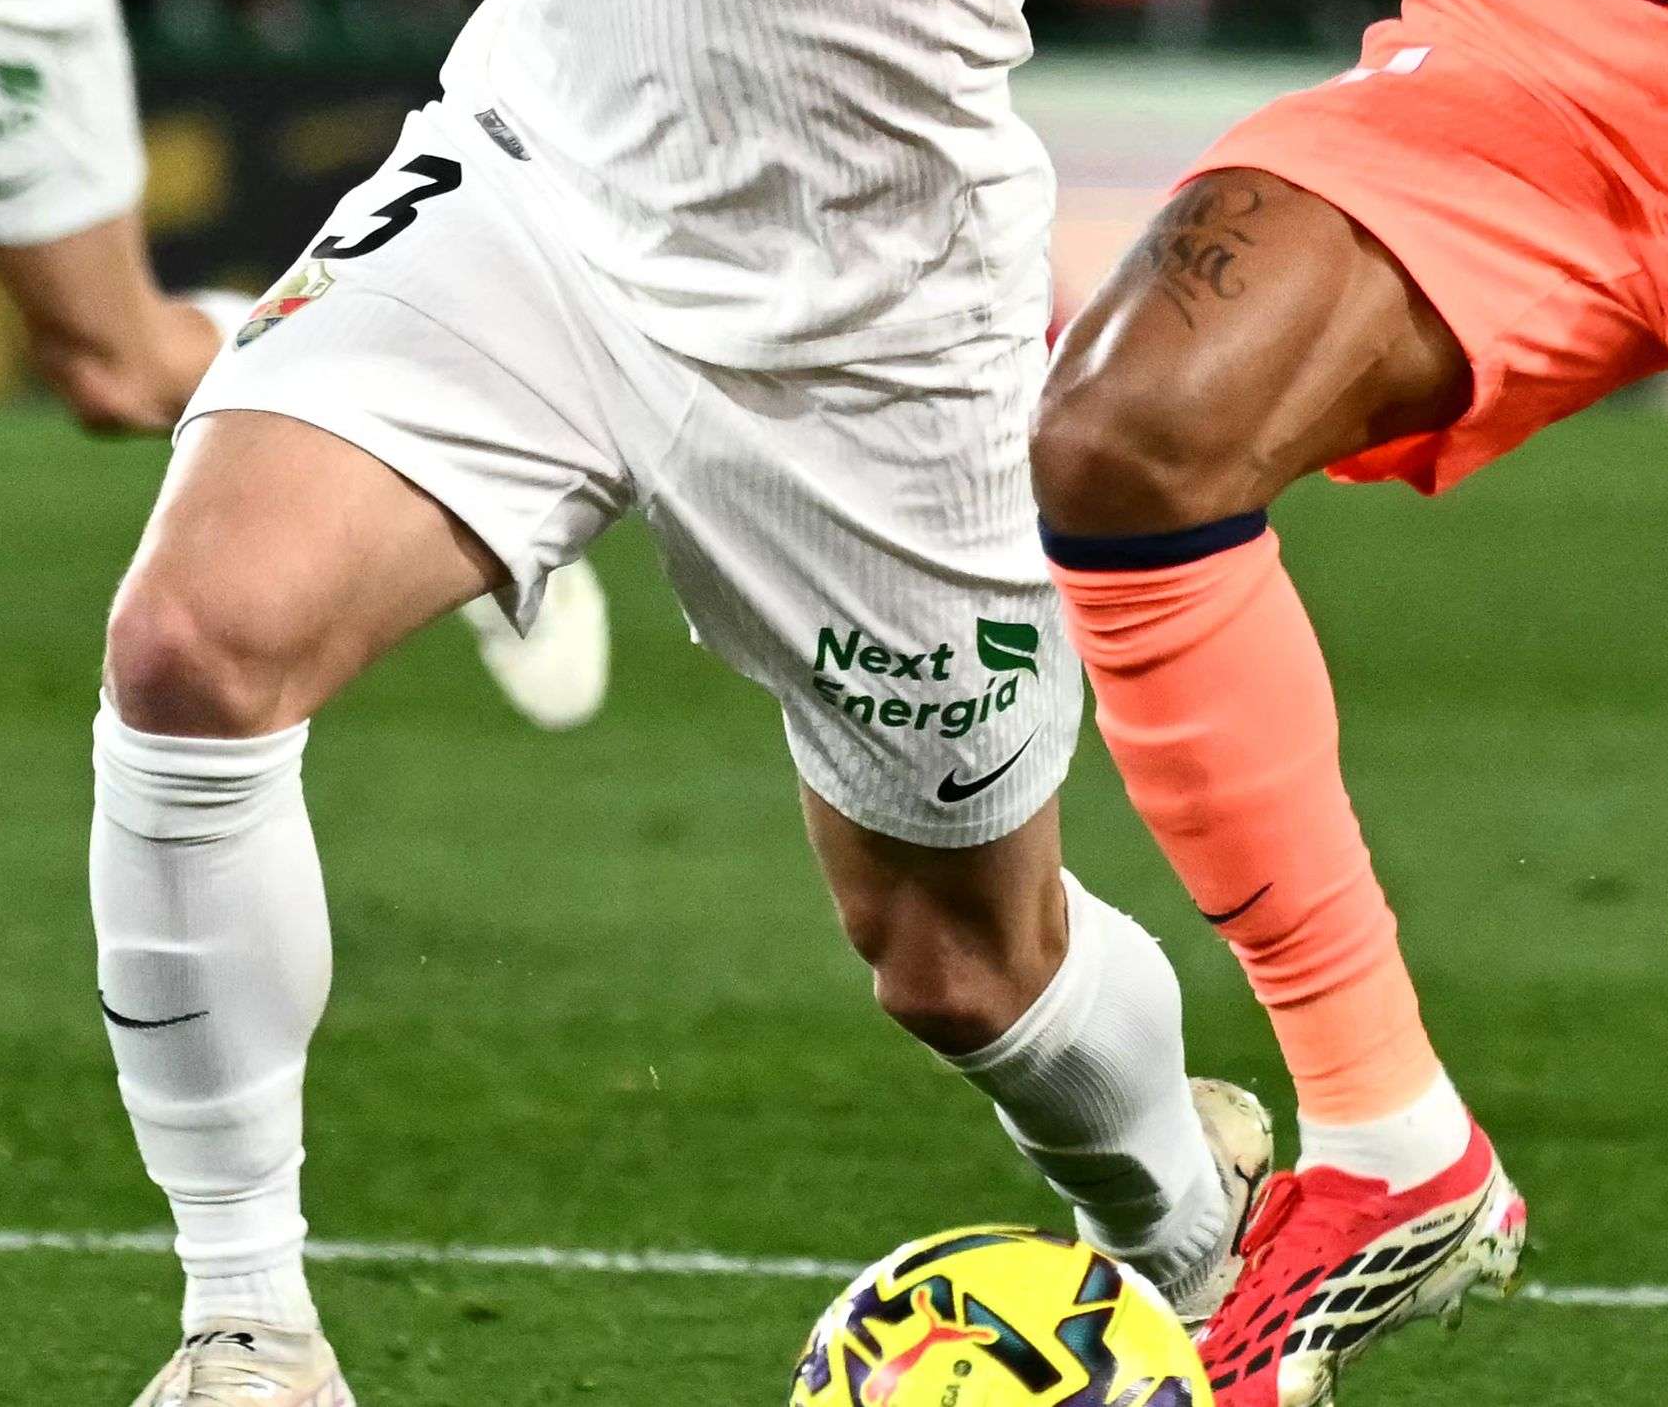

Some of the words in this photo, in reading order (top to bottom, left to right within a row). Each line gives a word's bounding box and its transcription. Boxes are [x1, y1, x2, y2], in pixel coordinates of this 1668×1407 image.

[310, 153, 463, 260] 3
[812, 626, 955, 682] Next
[812, 675, 1019, 738] Energía
